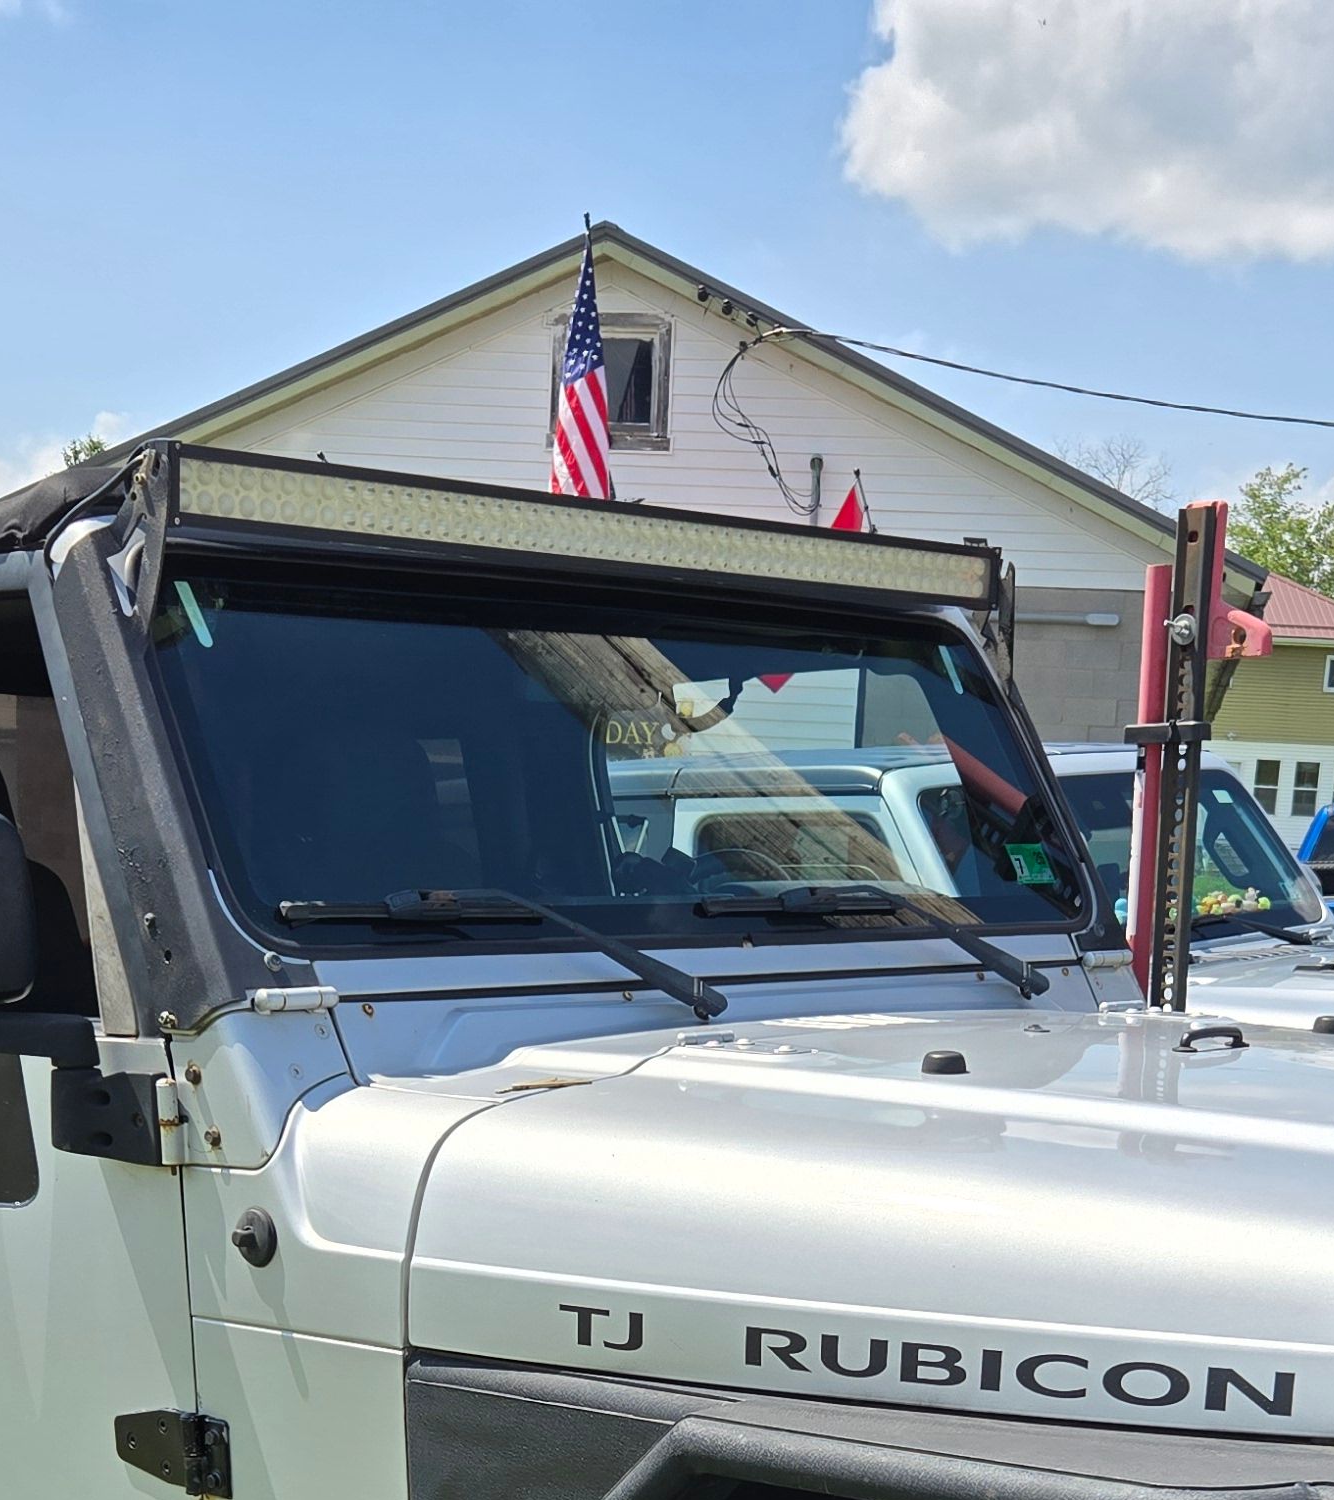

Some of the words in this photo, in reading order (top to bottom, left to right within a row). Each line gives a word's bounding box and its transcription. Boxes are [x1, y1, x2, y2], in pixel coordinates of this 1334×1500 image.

[1014, 858, 1024, 875] 7
[558, 1303, 645, 1352] TJ
[744, 1325, 1296, 1418] RUBICON
